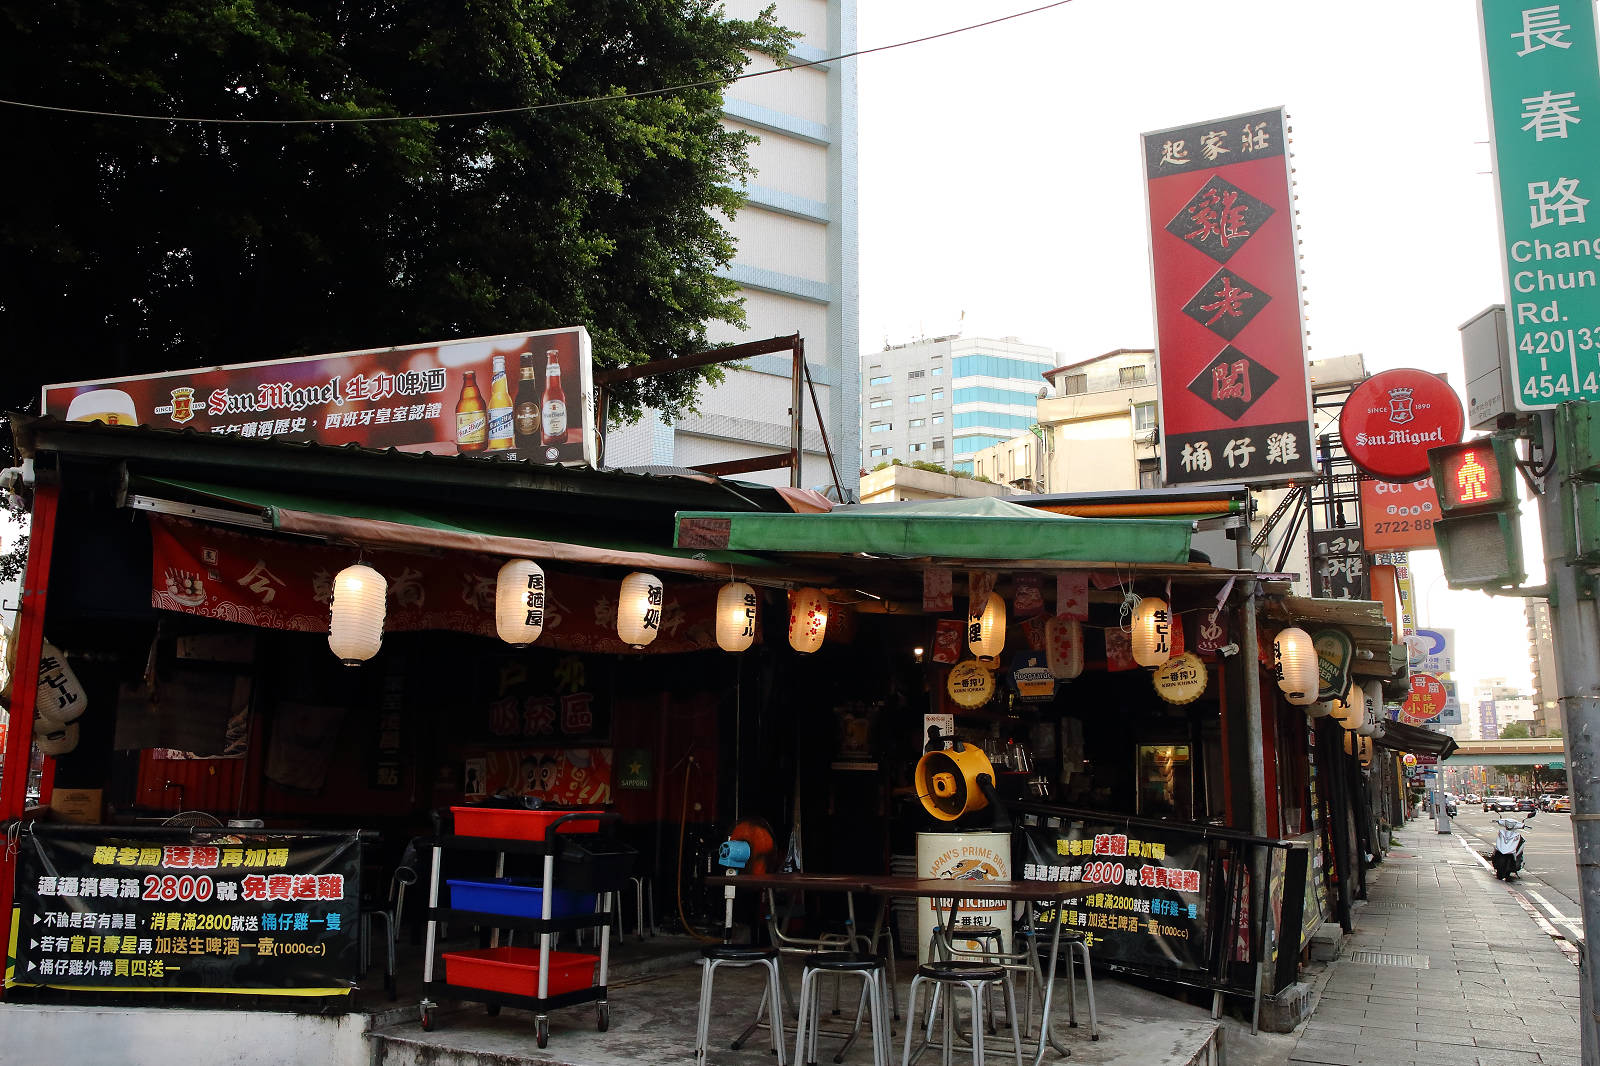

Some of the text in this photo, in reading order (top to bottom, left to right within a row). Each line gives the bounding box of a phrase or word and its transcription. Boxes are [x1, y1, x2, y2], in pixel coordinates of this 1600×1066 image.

[1511, 4, 1591, 229] 長春路
[1514, 268, 1597, 293] Chun
[1517, 300, 1568, 325] Rd.
[1519, 330, 1565, 355] 420
[208, 366, 447, 416] San Miguel 生力啤酒
[1523, 373, 1571, 399] 454
[1367, 402, 1431, 414] SINCE 1890
[1355, 426, 1443, 446] San Miguel
[1180, 431, 1300, 474] 桶仔雞
[1374, 518, 1440, 534] 2722-88
[525, 573, 544, 627] 居酒屋
[743, 593, 756, 637] 生ビール
[1153, 609, 1169, 654] 生ビール
[1161, 669, 1197, 682] 一番搾り
[1408, 703, 1437, 715] 小吃
[962, 846, 993, 859] PRIME
